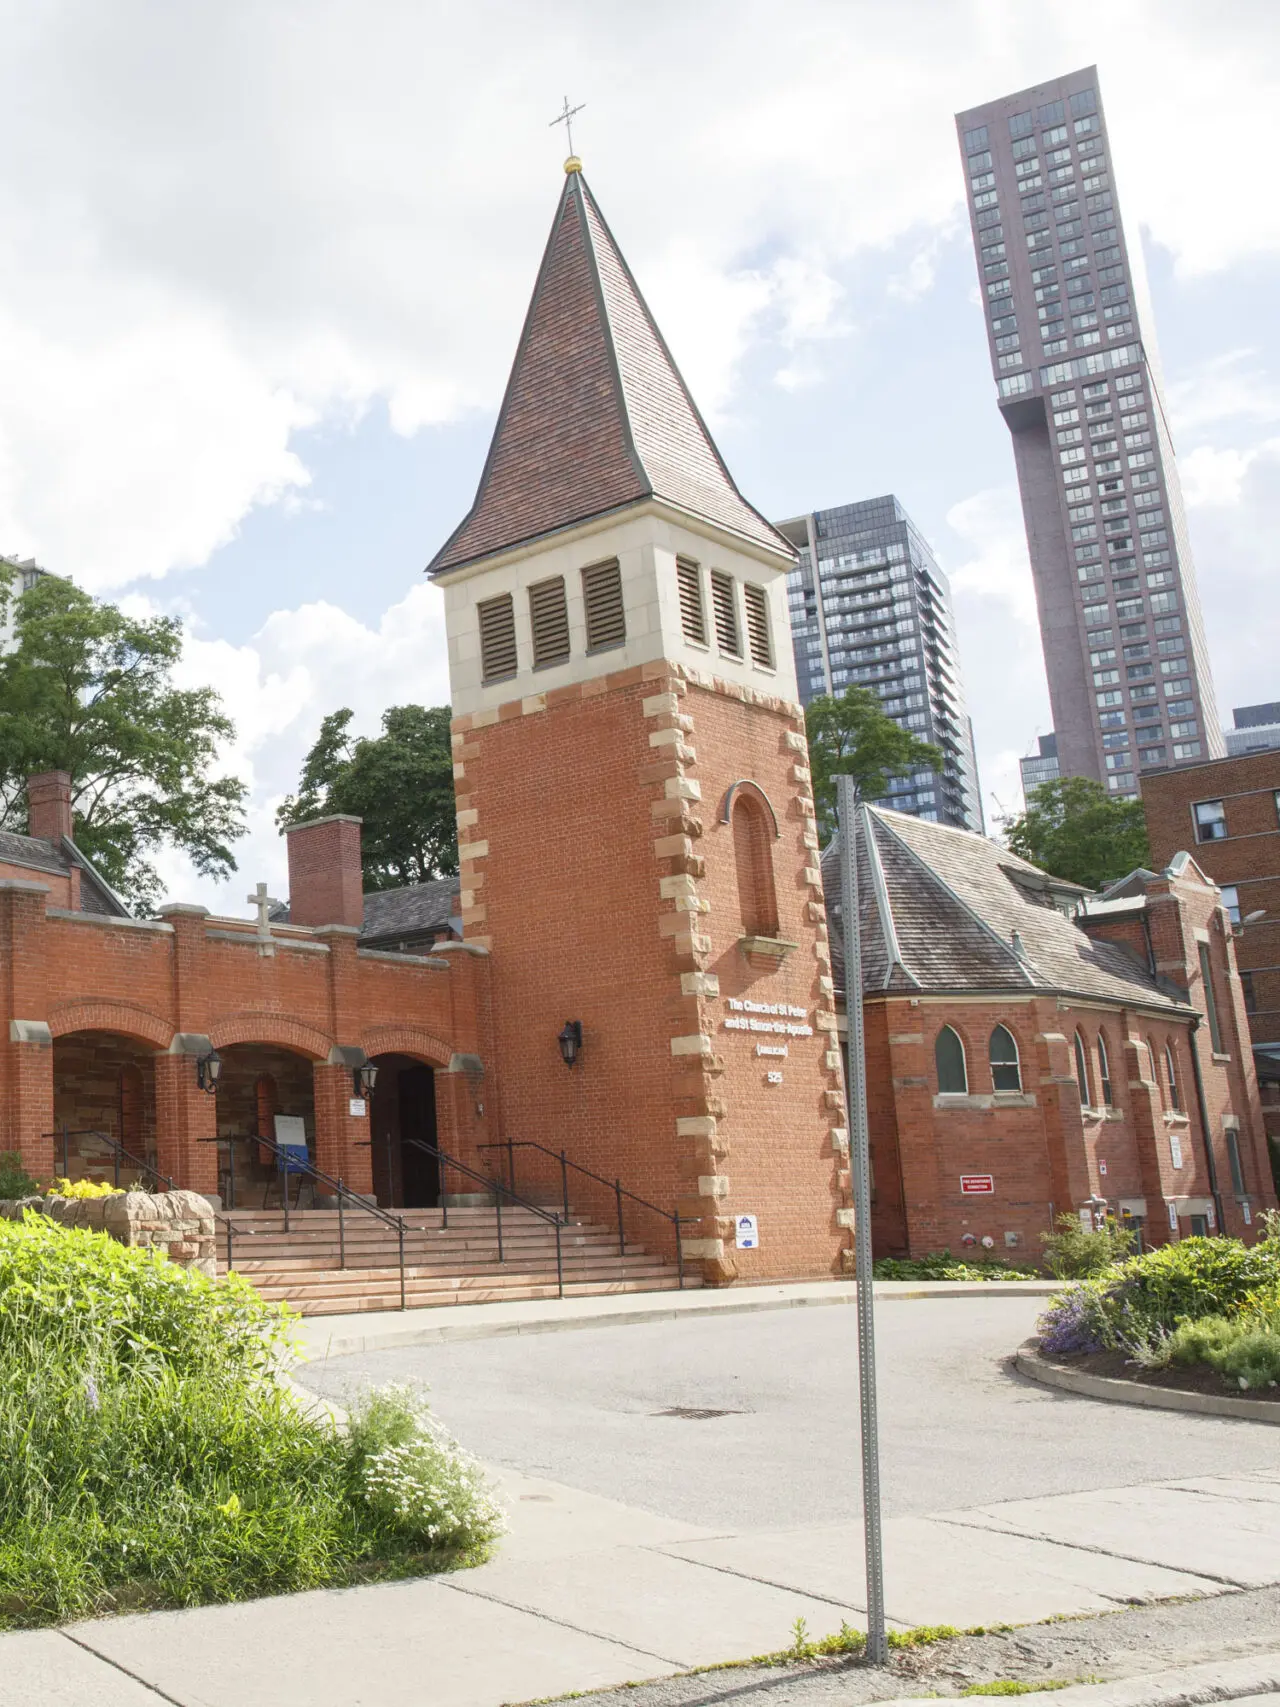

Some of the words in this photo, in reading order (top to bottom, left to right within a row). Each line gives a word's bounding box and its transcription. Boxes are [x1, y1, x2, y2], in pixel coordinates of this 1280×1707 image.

[728, 998, 743, 1011] The
[744, 1000, 771, 1014] Church
[770, 1003, 779, 1015] of
[787, 1005, 807, 1018] Peter
[724, 1015, 740, 1029] and
